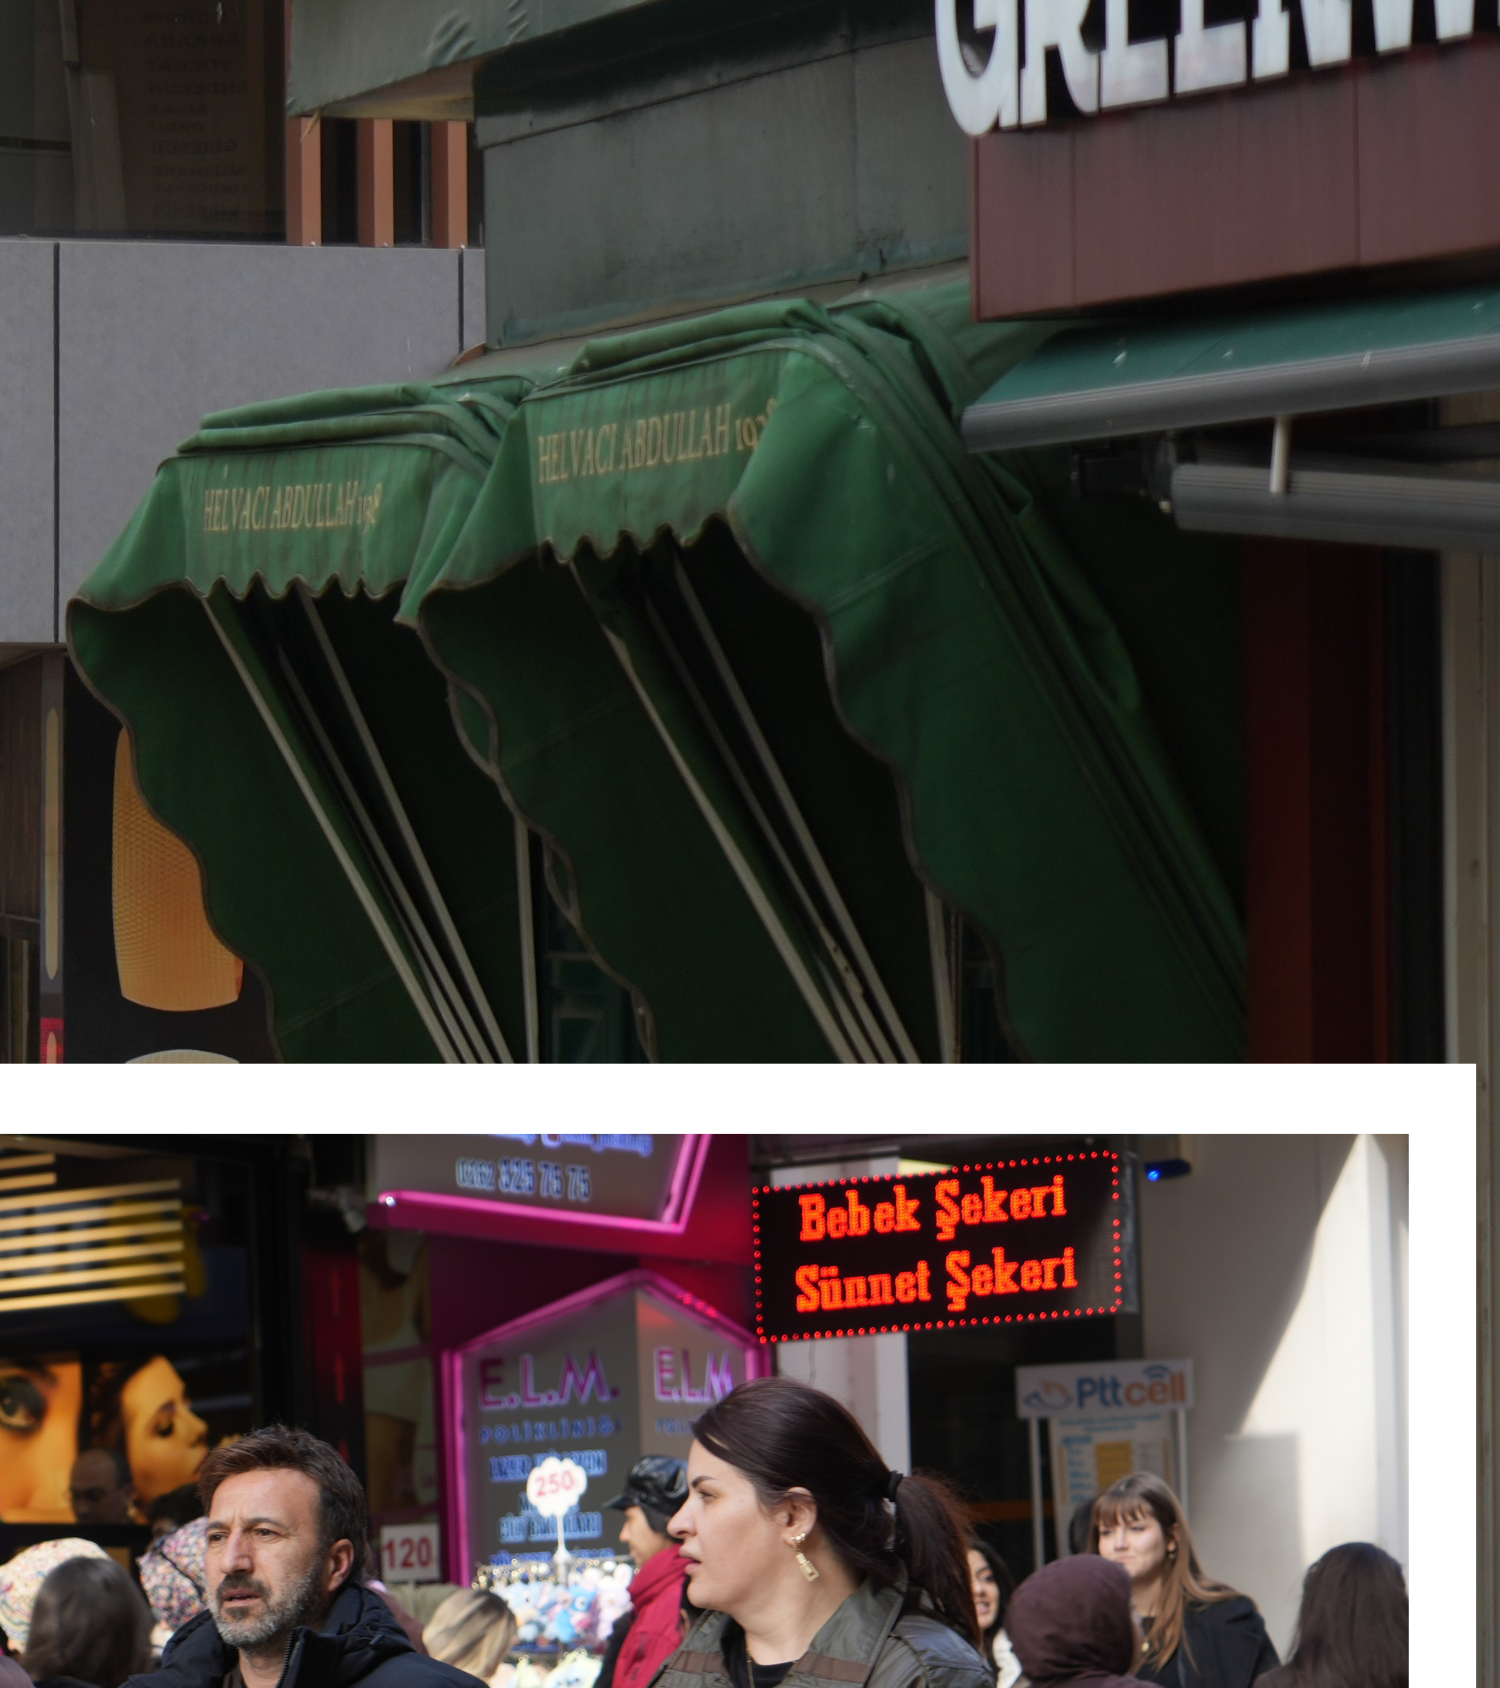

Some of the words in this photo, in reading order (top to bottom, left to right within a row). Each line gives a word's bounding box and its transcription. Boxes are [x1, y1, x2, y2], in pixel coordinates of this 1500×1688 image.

[537, 421, 619, 483] HELVACI
[618, 402, 733, 472] ABDULLAH
[203, 486, 271, 532] HELVACI
[269, 480, 360, 530] ABDULLAH
[799, 1184, 920, 1244] Bebek
[934, 1174, 1068, 1242] Şekeri
[794, 1259, 931, 1315] Sünnet
[945, 1245, 1079, 1313] Şekeri
[535, 1470, 575, 1497] 250
[382, 1536, 433, 1570] 120
